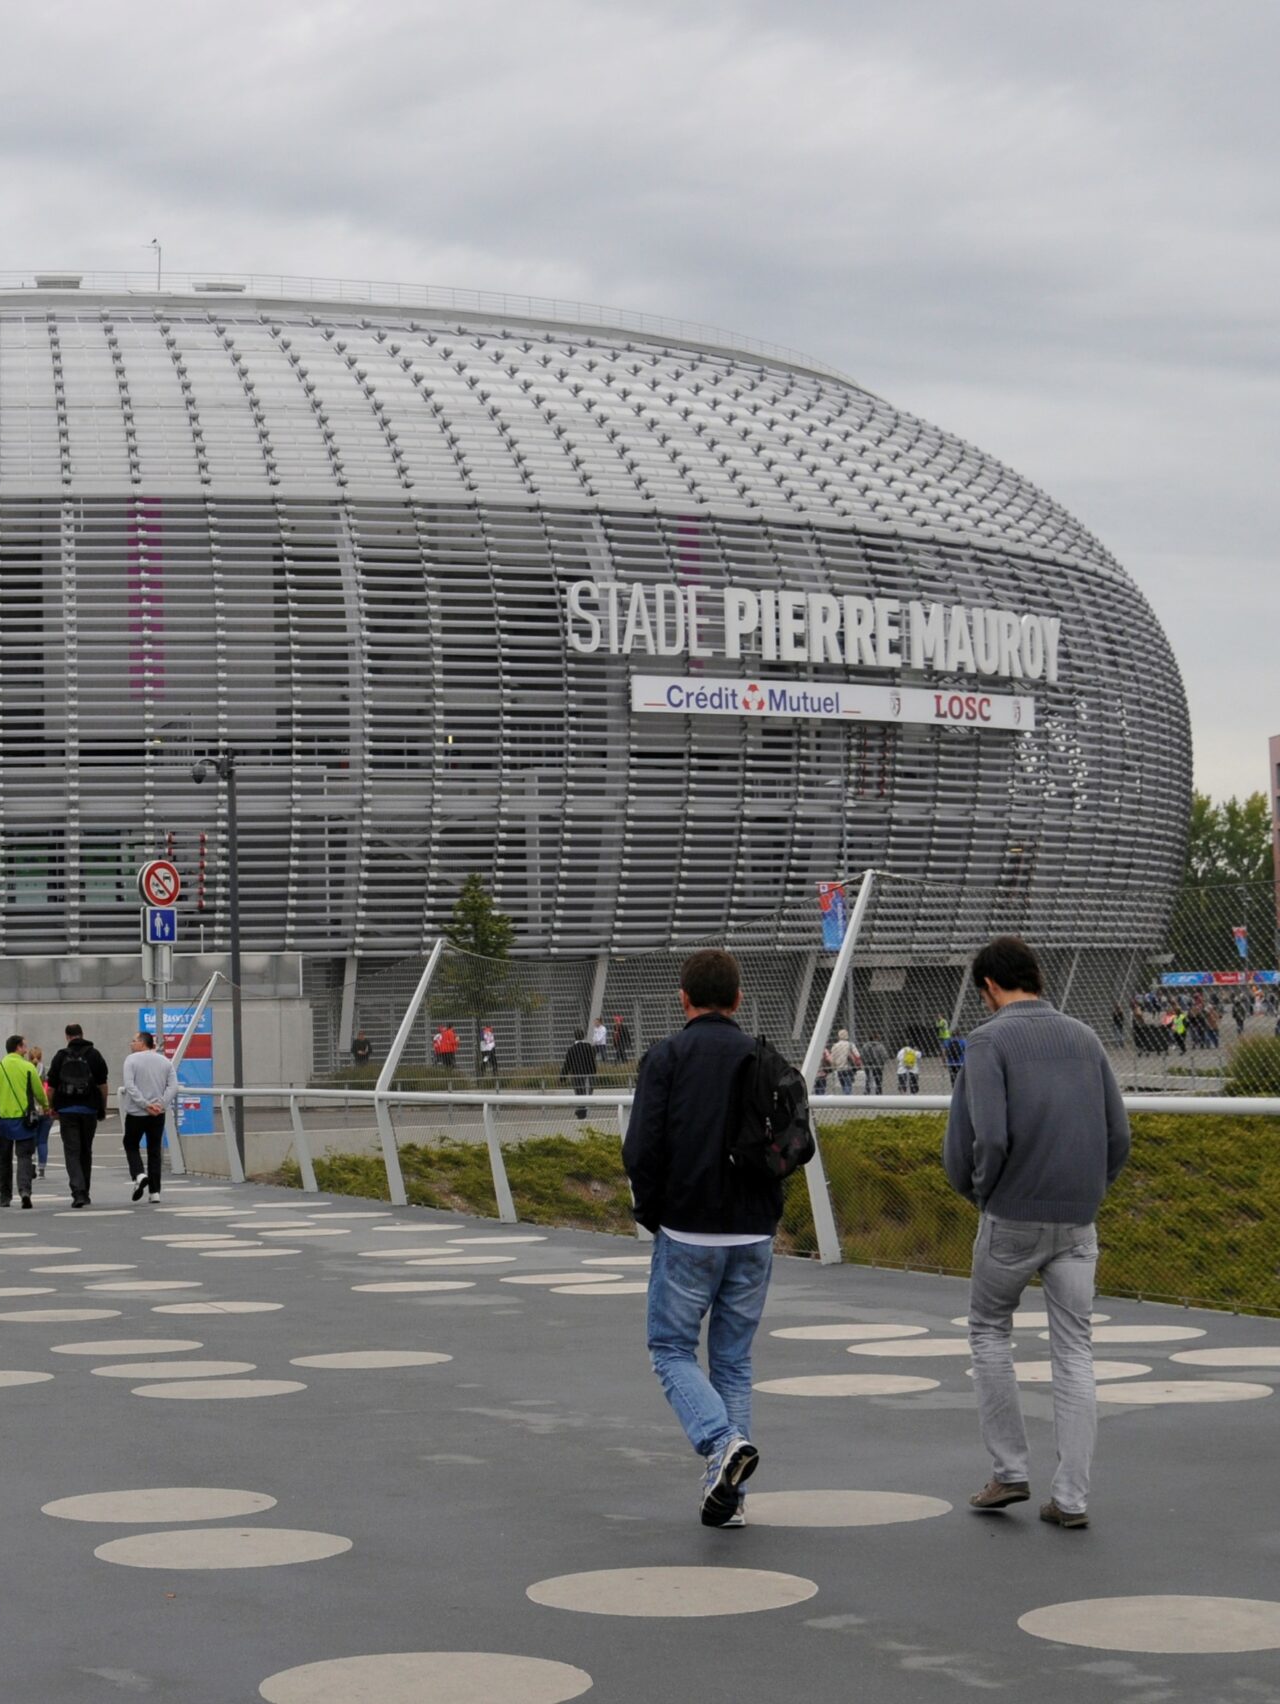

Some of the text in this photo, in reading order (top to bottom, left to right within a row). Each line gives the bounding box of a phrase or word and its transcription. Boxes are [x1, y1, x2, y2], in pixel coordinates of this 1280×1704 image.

[568, 580, 713, 657] STADE
[724, 587, 902, 668] PIERRE
[909, 601, 1061, 682] MAUROY
[666, 684, 840, 713] Crédit Mutuel
[934, 694, 991, 721] LOSC
